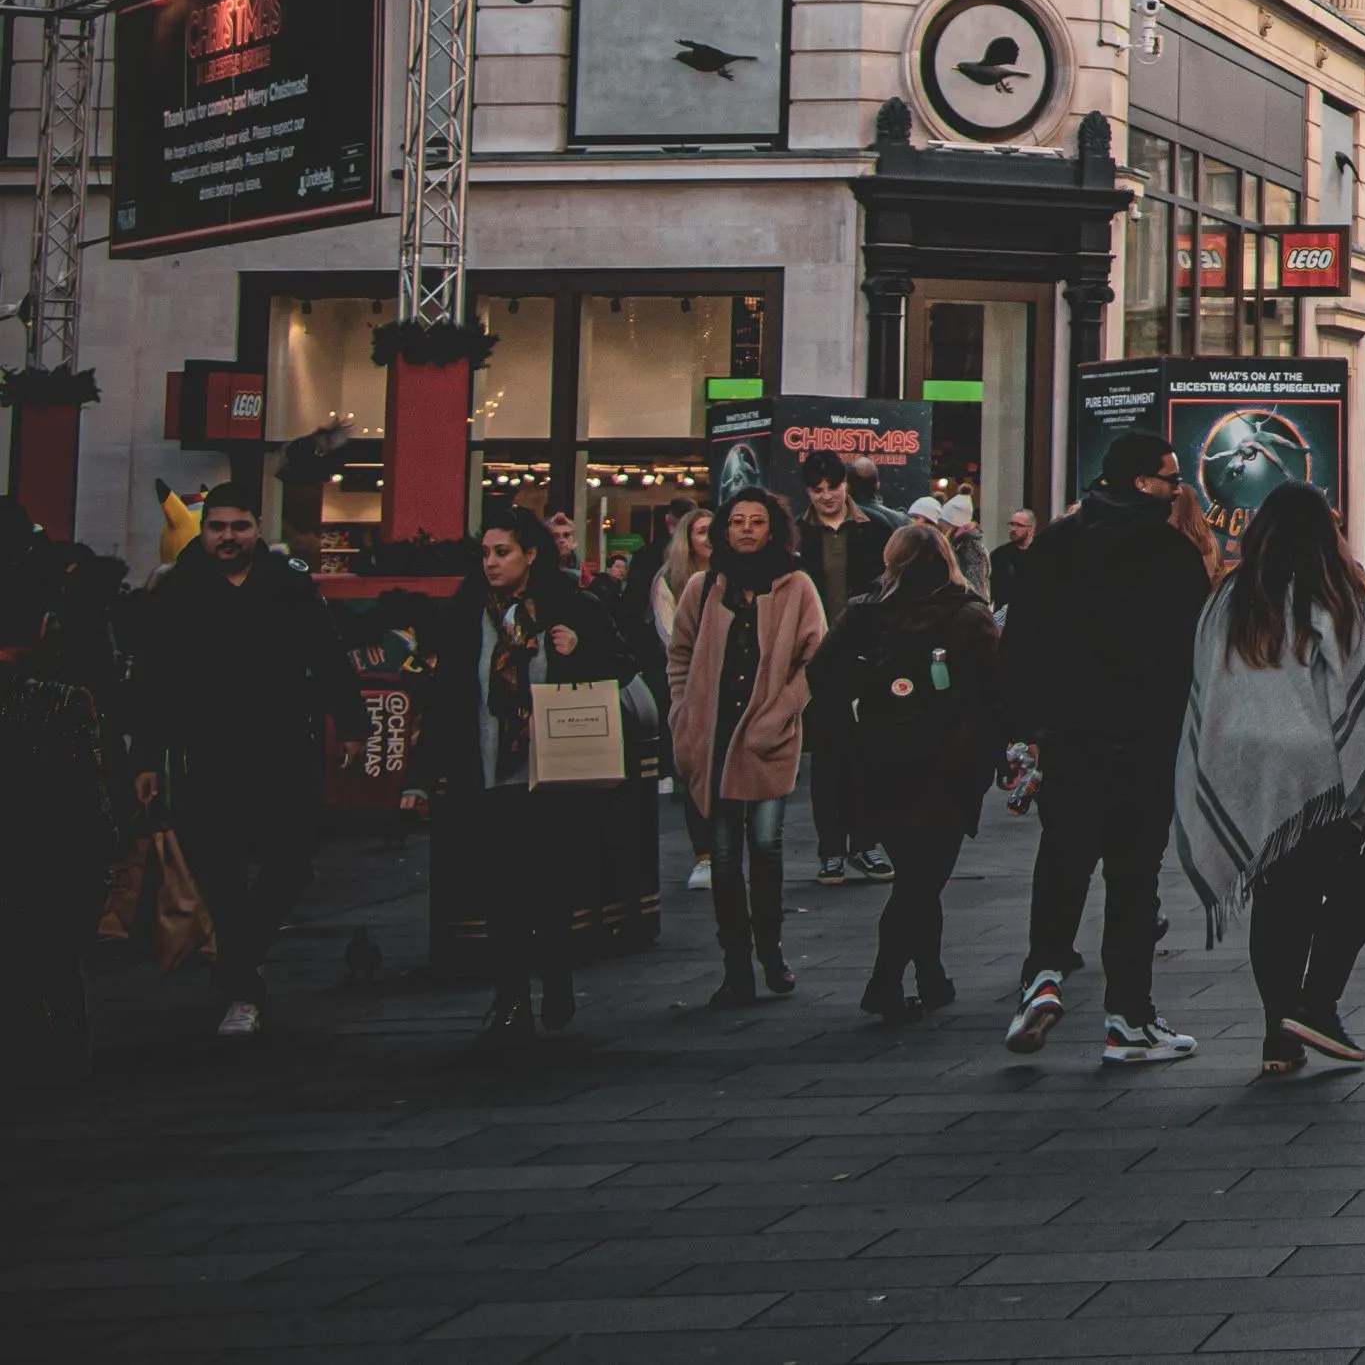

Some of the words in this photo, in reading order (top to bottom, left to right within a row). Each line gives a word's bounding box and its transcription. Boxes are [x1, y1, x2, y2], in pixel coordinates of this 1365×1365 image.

[163, 106, 184, 128] Thank
[207, 95, 233, 116] coming
[233, 89, 246, 111] and
[1286, 249, 1333, 269] LEGO
[1170, 382, 1226, 393] LEICESTER
[1228, 383, 1271, 393] SQUARE
[1273, 383, 1340, 394] SPIEGELTENT
[1209, 371, 1249, 381] WHAT'S
[1251, 371, 1265, 381] ON
[1268, 372, 1282, 381] AT
[1283, 372, 1303, 382] THE
[232, 391, 263, 420] LEGO
[1085, 395, 1102, 409] PURE
[1103, 392, 1155, 407] ENTERTAINMENT
[830, 414, 869, 426] Welcome
[870, 416, 880, 426] to
[784, 426, 920, 453] CHRISTMAS
[1206, 503, 1225, 529] LA
[385, 691, 410, 771] @CHRIS
